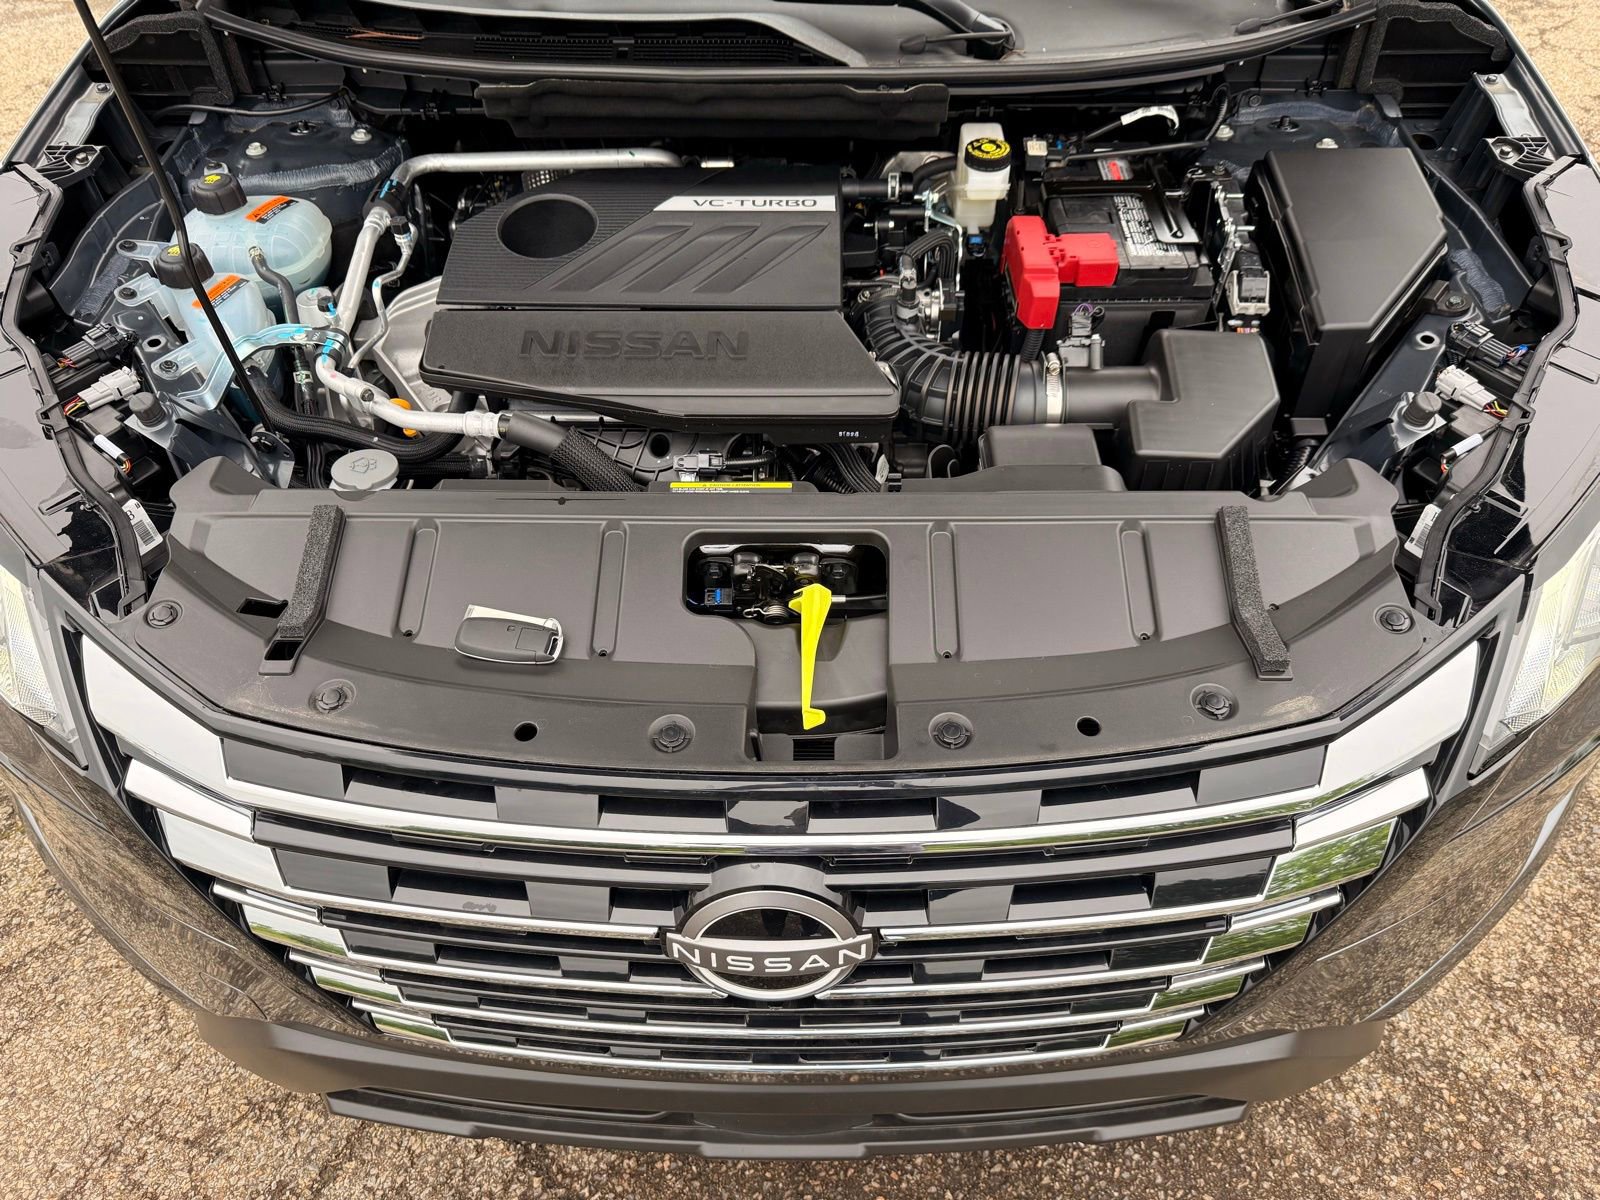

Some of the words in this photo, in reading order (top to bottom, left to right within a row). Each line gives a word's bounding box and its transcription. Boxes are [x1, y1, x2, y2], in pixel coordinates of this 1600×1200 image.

[693, 199, 817, 207] VC-TURBO
[519, 329, 748, 359] NISSAN
[672, 942, 867, 973] NISSAN
